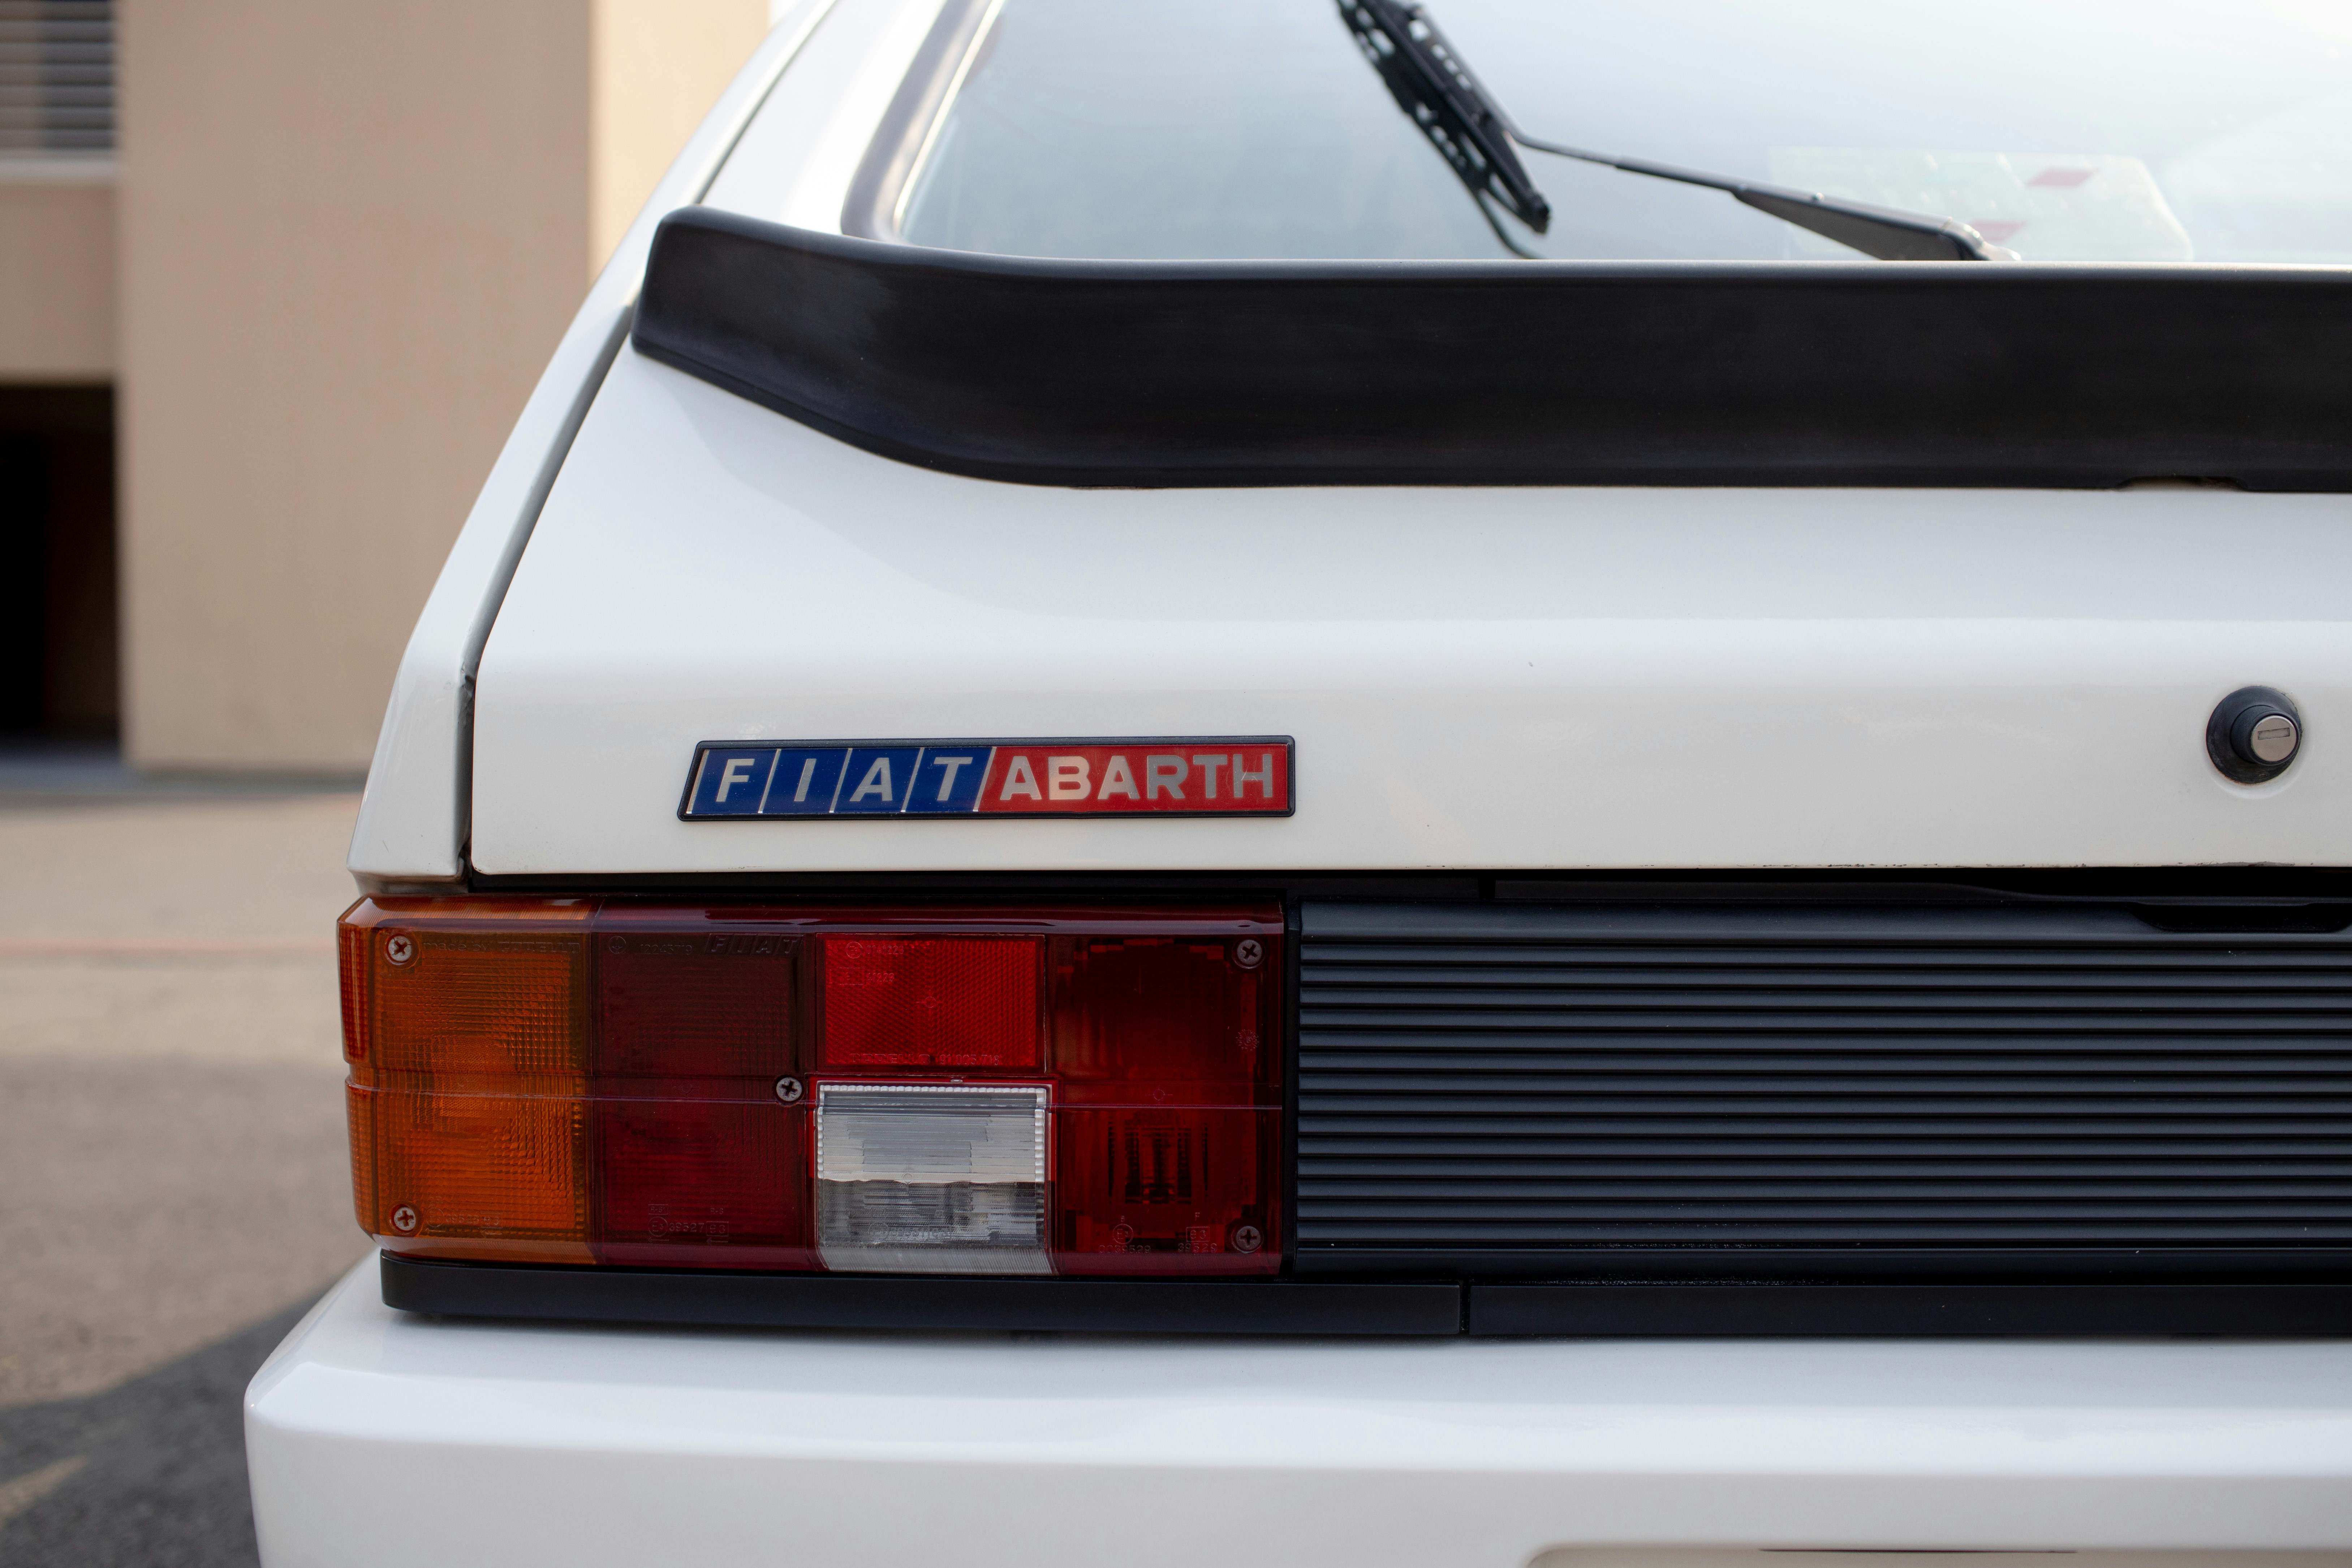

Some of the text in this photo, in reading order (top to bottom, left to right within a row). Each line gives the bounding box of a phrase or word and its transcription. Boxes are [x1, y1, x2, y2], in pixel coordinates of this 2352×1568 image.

[716, 754, 1273, 802] FIAT ABARTH
[423, 941, 467, 951] made
[471, 941, 486, 954] by
[710, 935, 798, 954] FIAT
[1194, 1211, 1201, 1221] F
[669, 1222, 705, 1232] 39527
[1178, 1242, 1218, 1254] 39529
